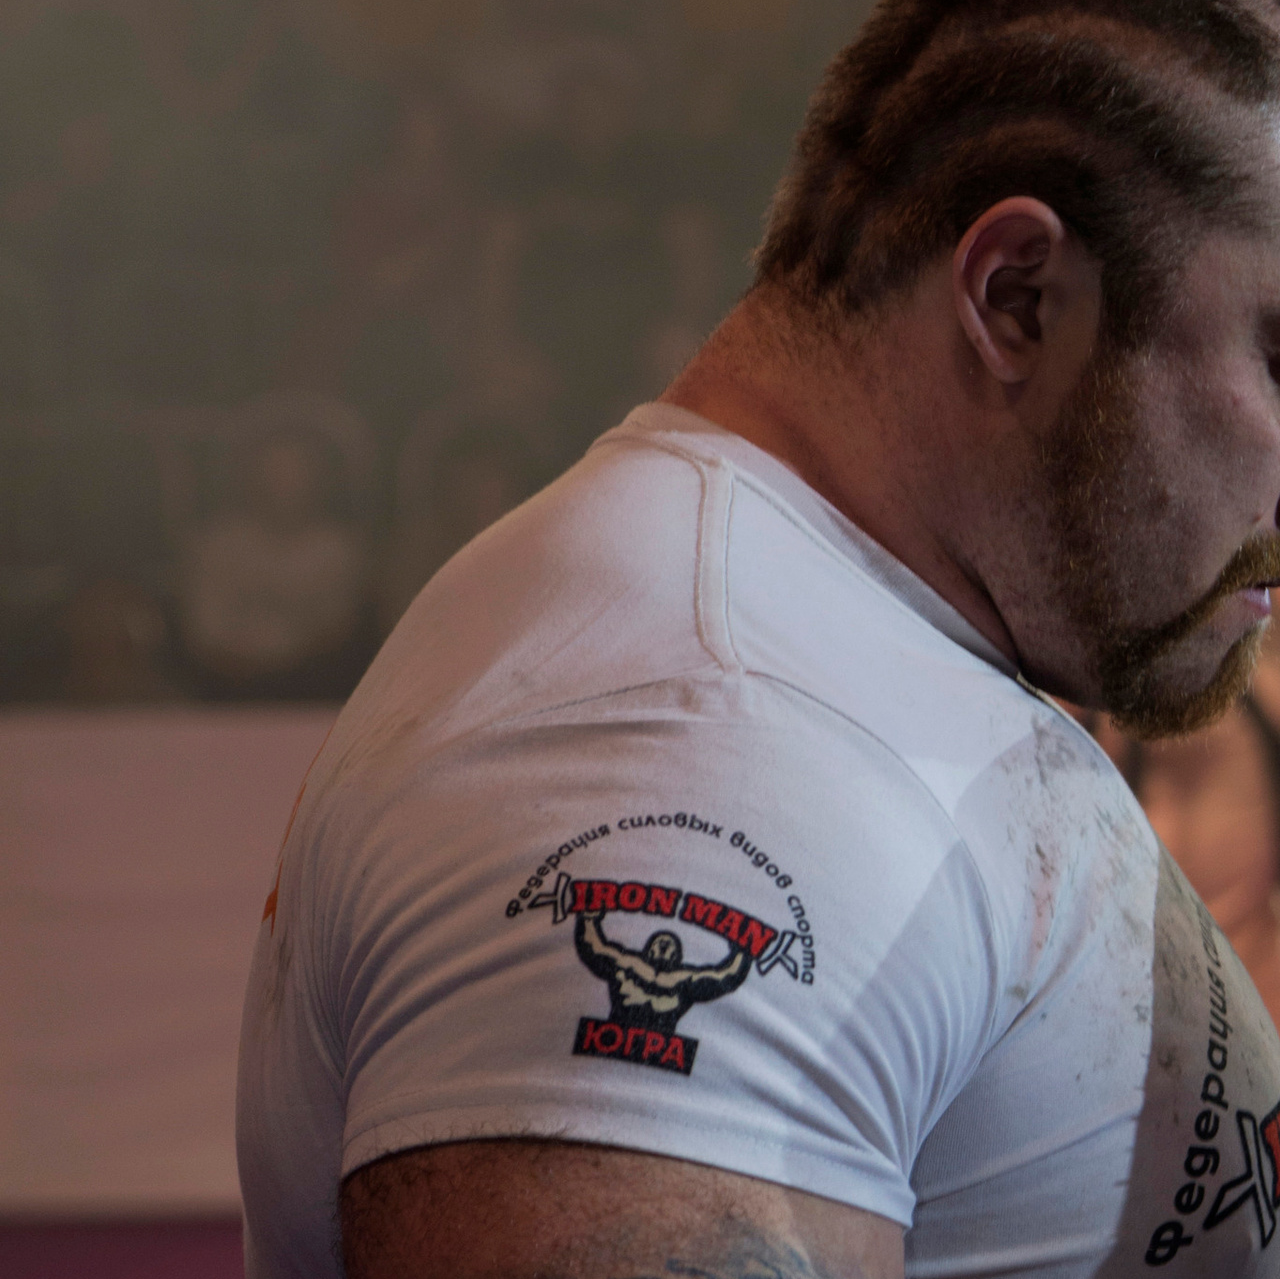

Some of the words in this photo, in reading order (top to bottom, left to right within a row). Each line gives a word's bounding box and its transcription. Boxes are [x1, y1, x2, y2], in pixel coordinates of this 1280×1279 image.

[569, 881, 683, 916] IRON
[680, 894, 778, 960] MAN
[617, 812, 722, 839] силовых
[729, 831, 792, 889] видов
[787, 895, 816, 986] спорта
[582, 1021, 685, 1069] ЮГРА
